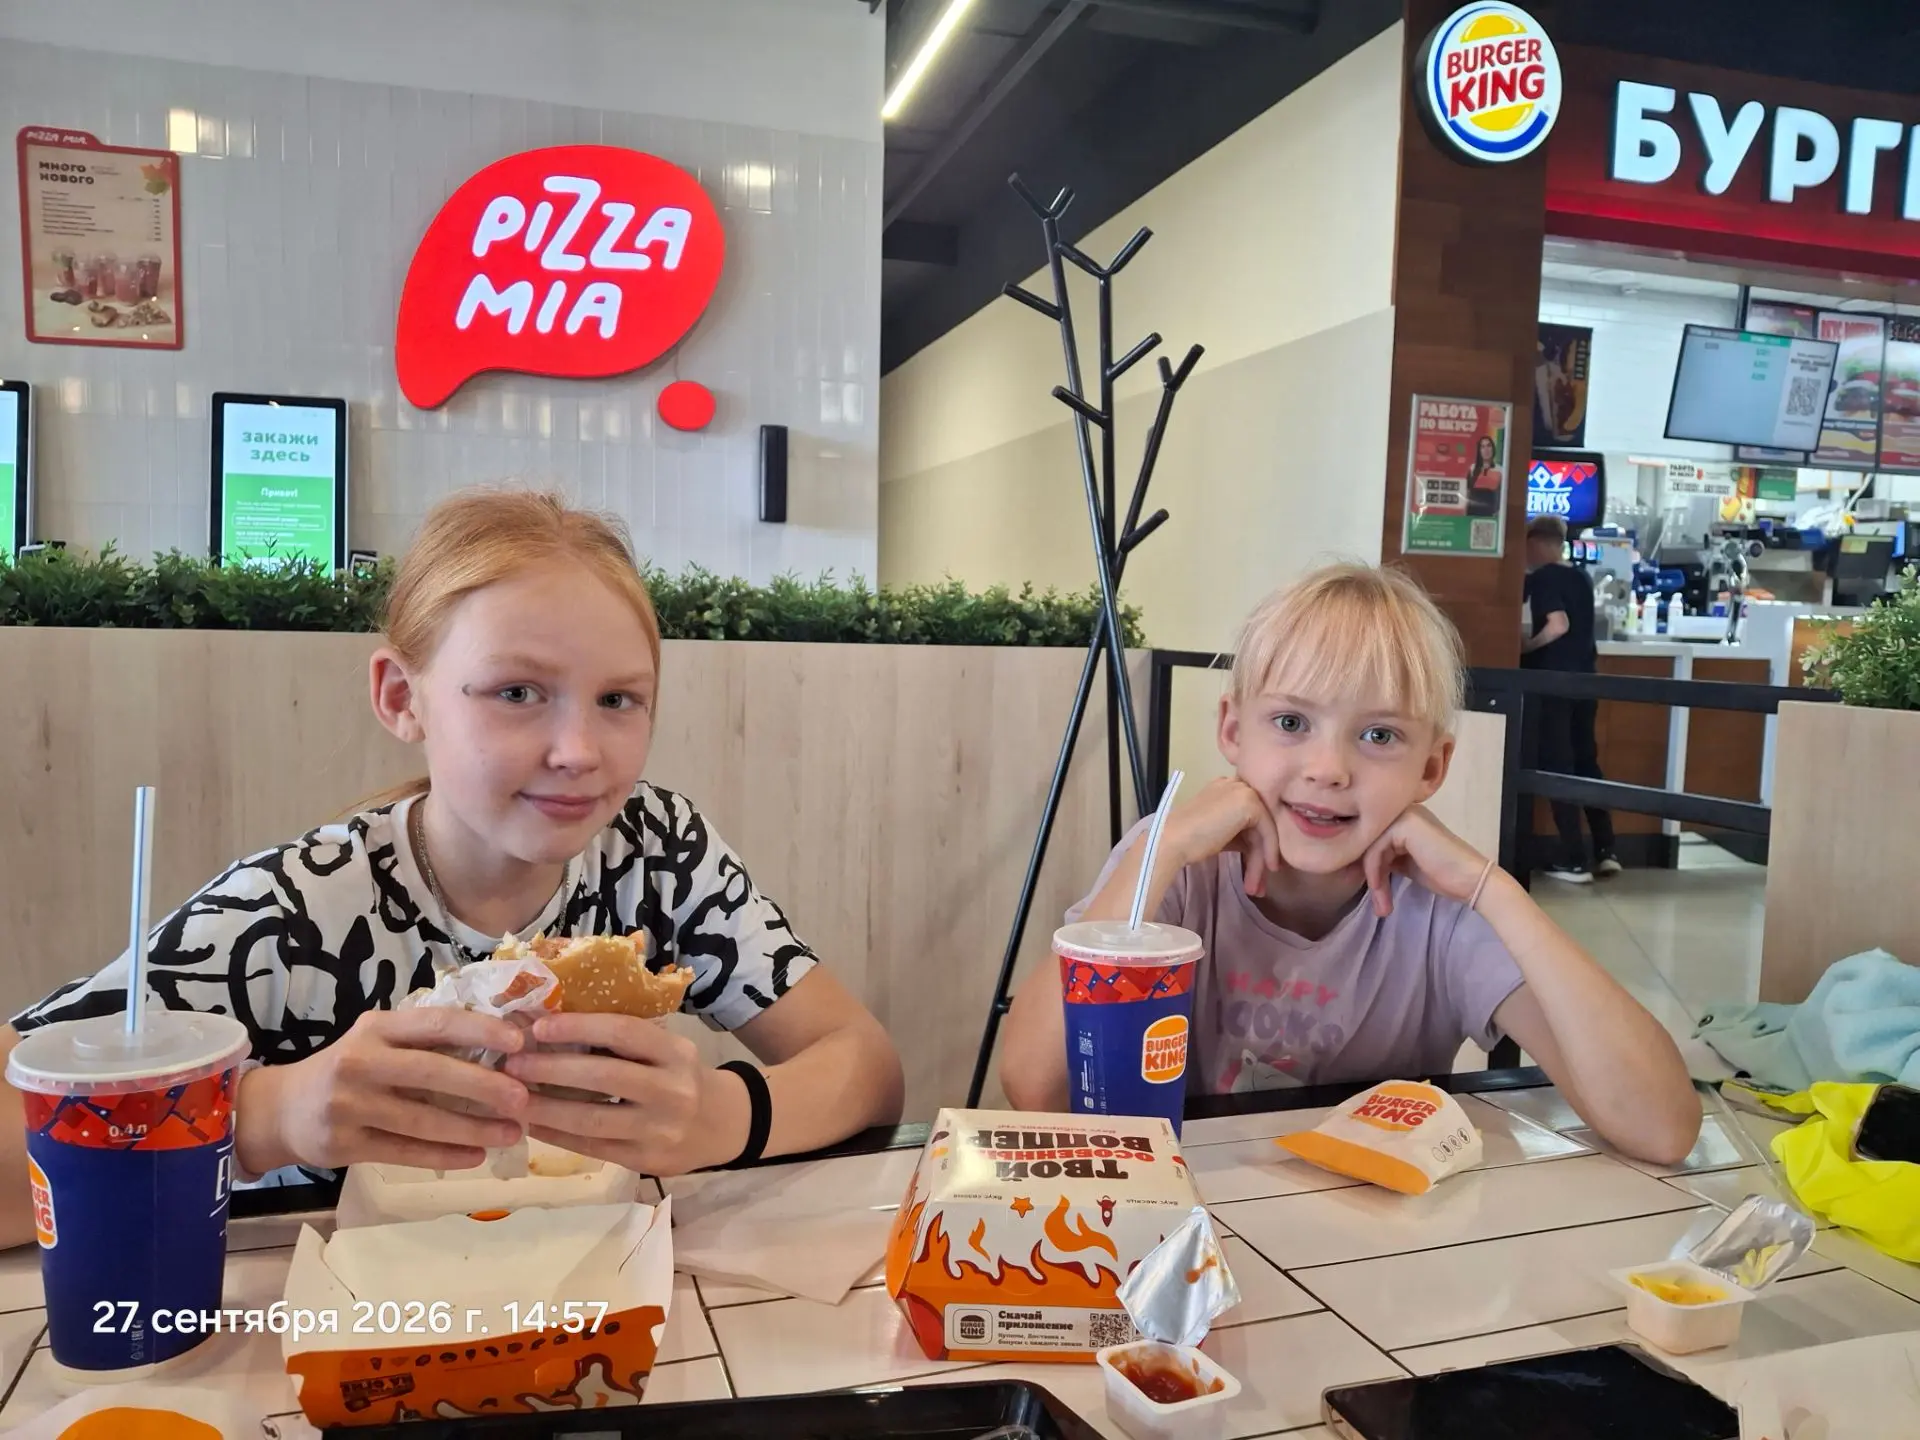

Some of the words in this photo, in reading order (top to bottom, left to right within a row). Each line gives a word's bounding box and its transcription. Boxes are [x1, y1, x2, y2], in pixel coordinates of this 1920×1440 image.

[1446, 38, 1542, 80] BURGER
[1449, 65, 1546, 119] KING
[1613, 80, 1920, 221] БУРГ
[455, 273, 623, 339] MIA
[1420, 402, 1478, 419] РАБОТА
[242, 431, 319, 446] закажи
[251, 449, 310, 463] здесь
[1146, 1033, 1186, 1052] BURGER
[1145, 1048, 1186, 1070] KING
[1352, 1104, 1430, 1126] KING
[1366, 1094, 1437, 1116] BURGER
[967, 1130, 1153, 1153] ВОППЕР
[974, 1148, 1155, 1162] ОСОБЕННЫ
[995, 1159, 1129, 1182] ТВОЙ
[998, 1310, 1043, 1321] Скачай
[998, 1320, 1073, 1331] приложение
[961, 1327, 985, 1335] KING
